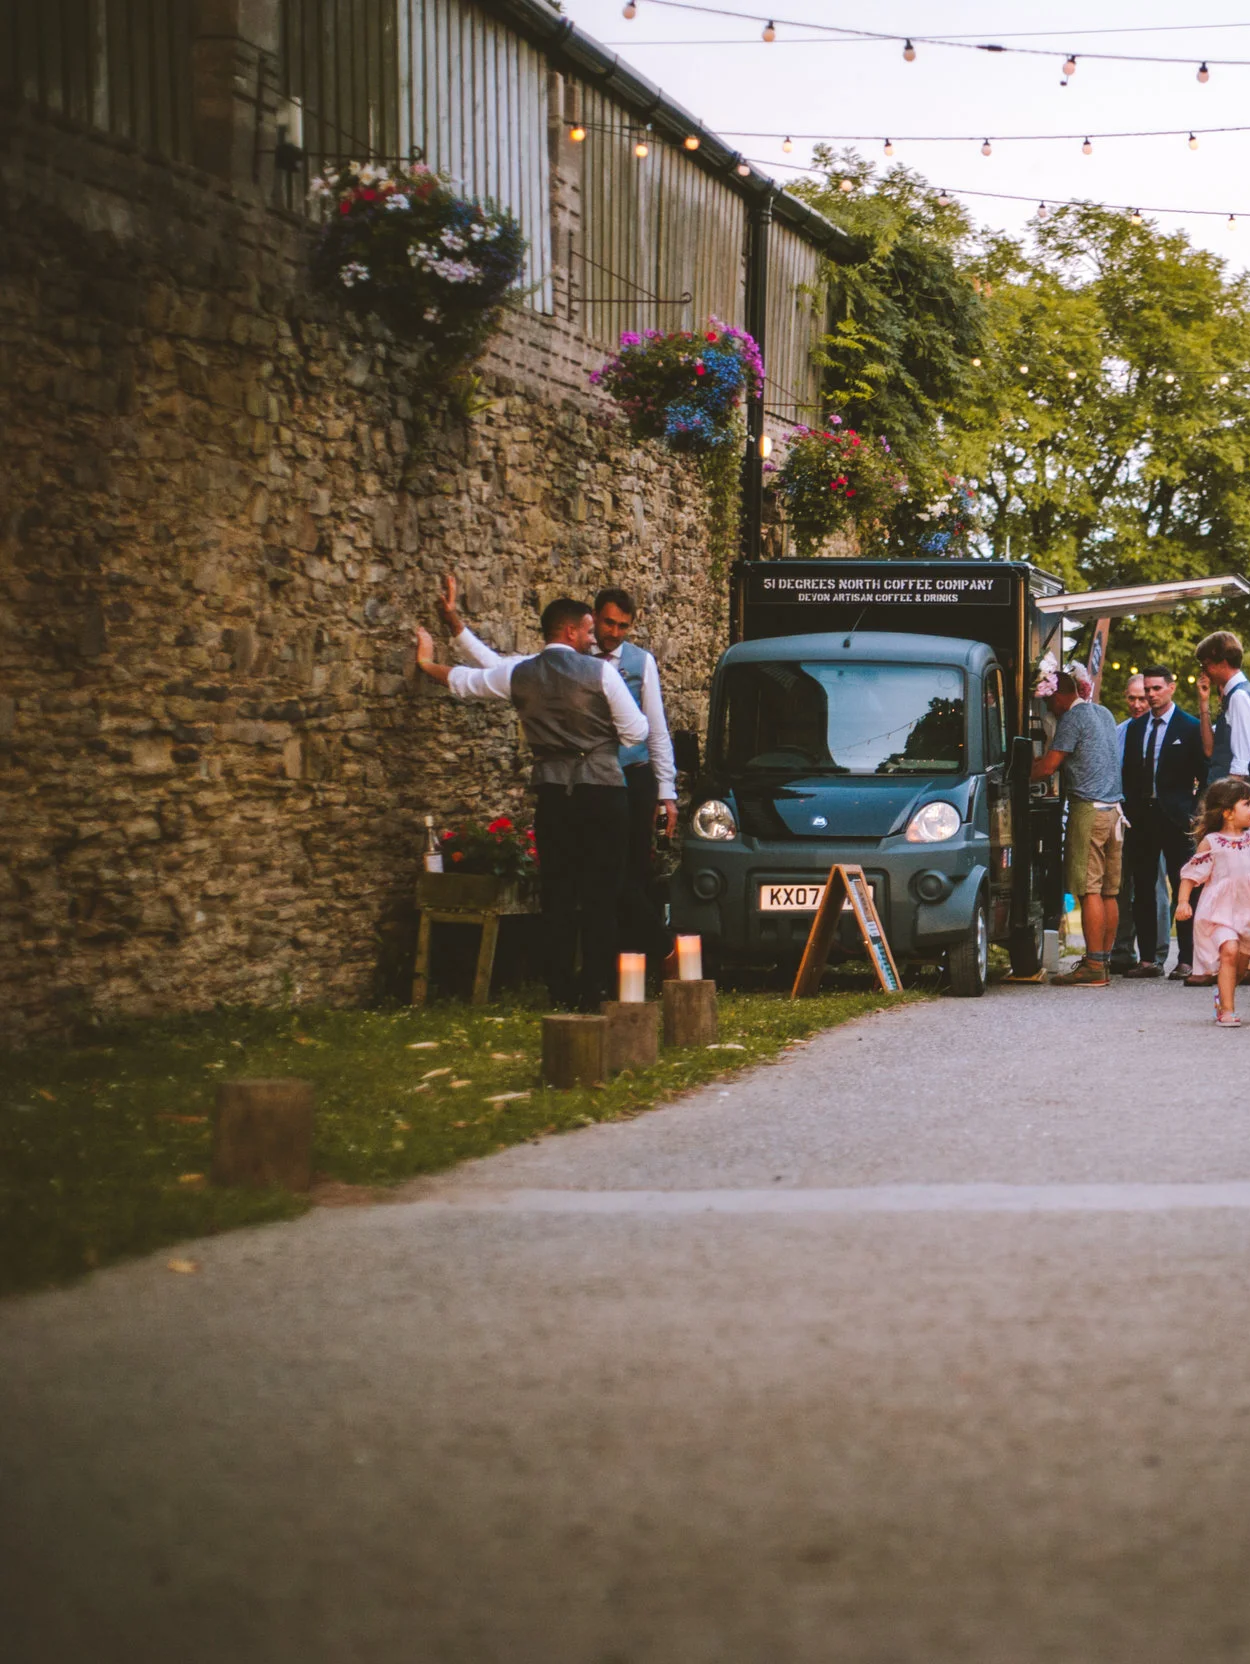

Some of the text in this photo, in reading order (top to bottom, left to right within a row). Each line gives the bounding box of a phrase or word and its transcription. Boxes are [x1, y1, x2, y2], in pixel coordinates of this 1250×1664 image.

[778, 578, 836, 590] DEGREES
[838, 578, 881, 590] NORTH
[883, 578, 933, 591] COFFEE
[935, 578, 994, 591] COMPANY
[798, 593, 959, 602] DEVON ARTISAN COFFEE & DRINKS
[770, 887, 821, 906] KX07
